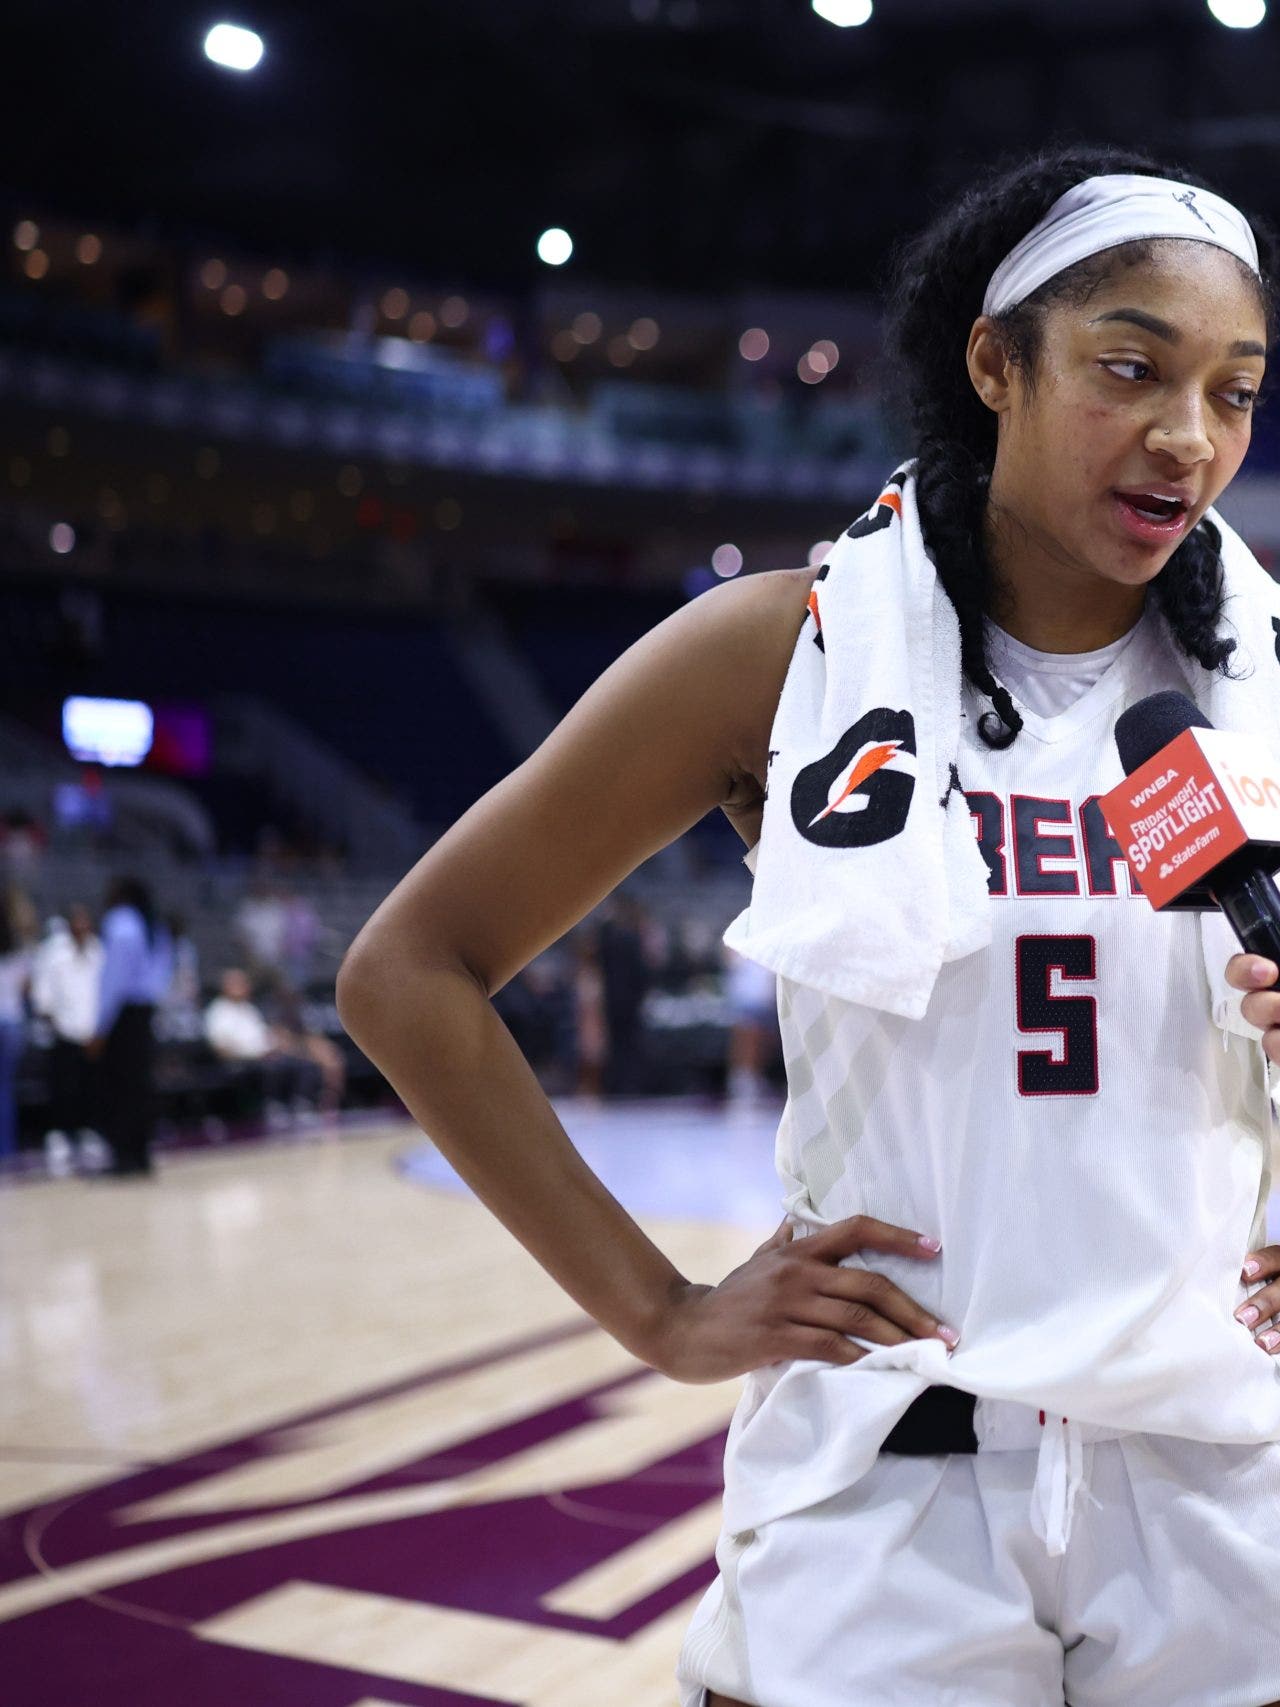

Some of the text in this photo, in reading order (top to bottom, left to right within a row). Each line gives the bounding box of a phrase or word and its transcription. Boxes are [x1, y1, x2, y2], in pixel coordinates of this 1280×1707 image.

[1130, 768, 1179, 808] WNBA
[1130, 776, 1198, 839] FRIDAY NIGHT
[1128, 782, 1223, 872] SPOTLIGHT
[1015, 935, 1100, 1096] 5
